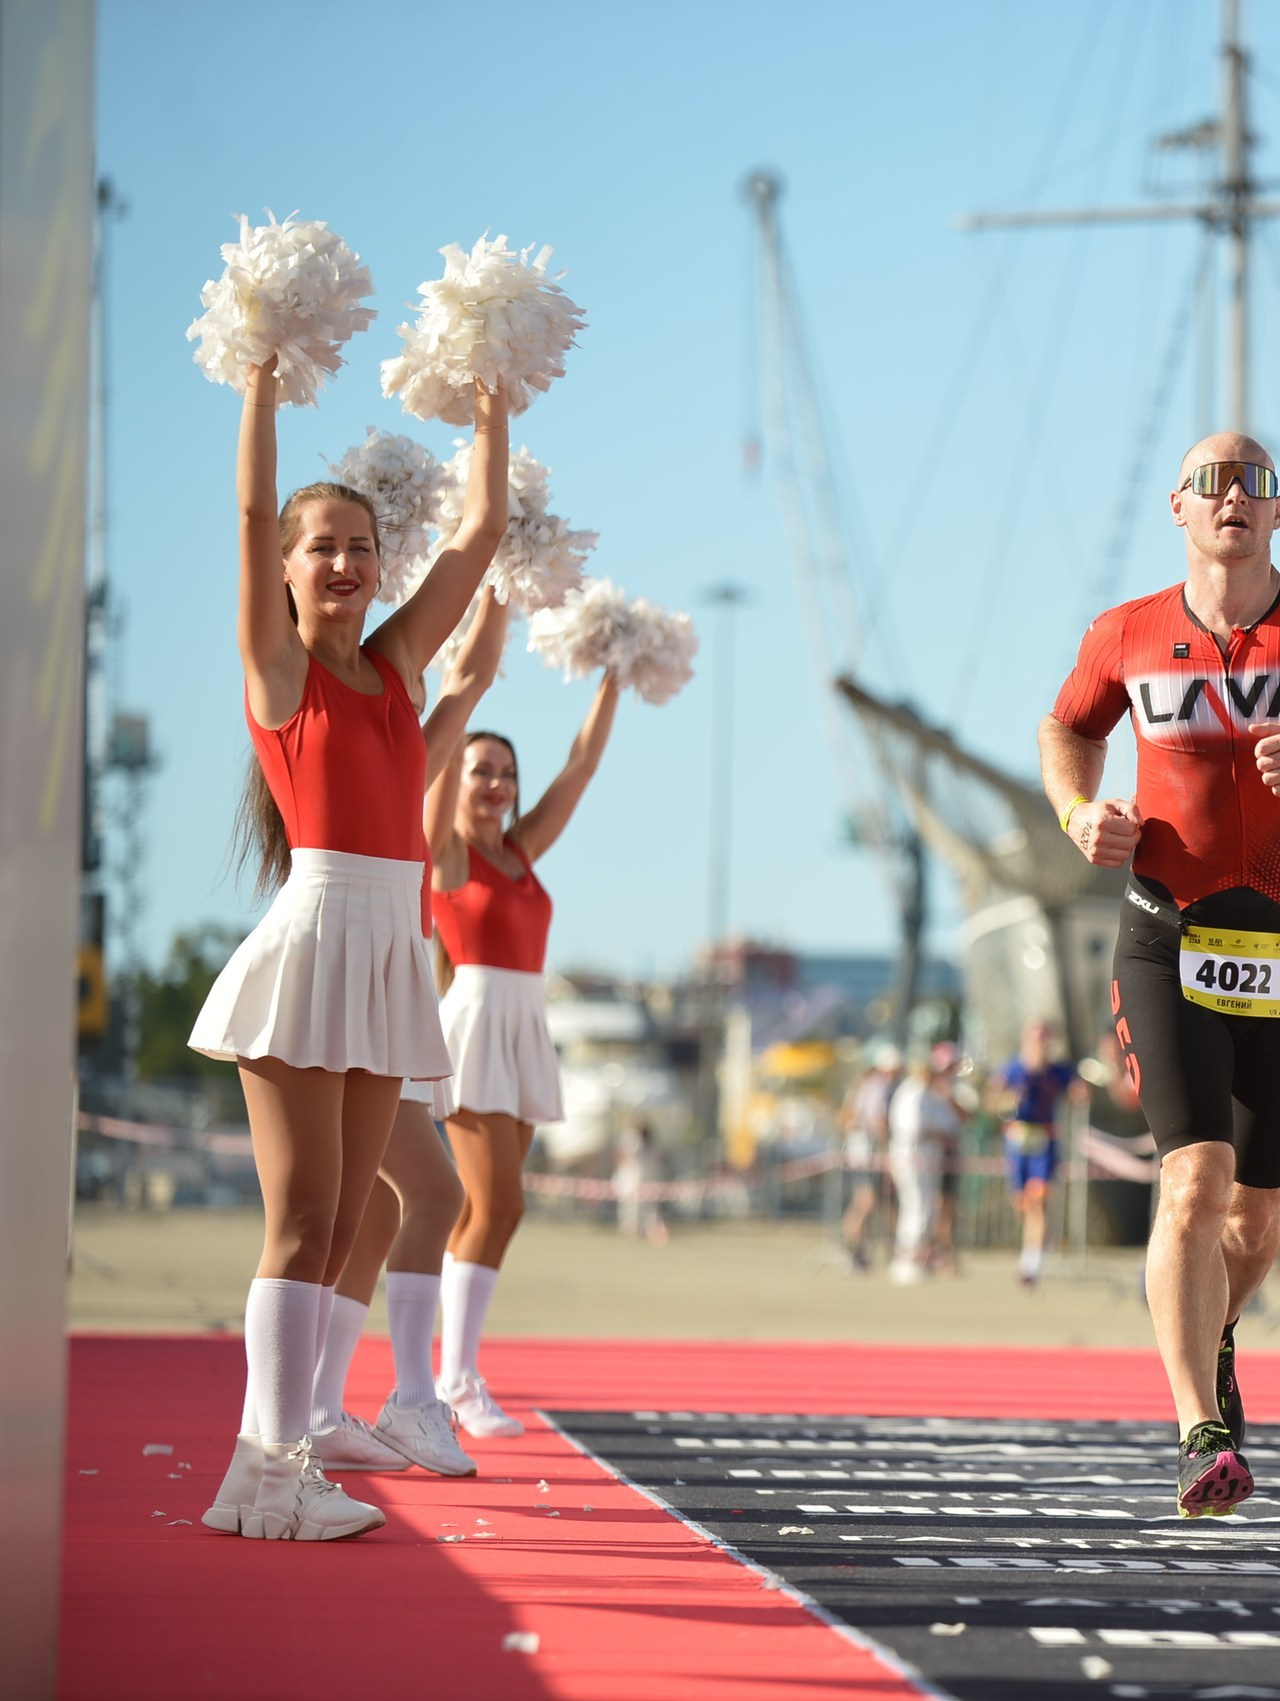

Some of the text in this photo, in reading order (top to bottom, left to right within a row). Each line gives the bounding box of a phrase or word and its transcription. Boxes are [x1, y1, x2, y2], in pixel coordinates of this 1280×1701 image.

[1128, 890, 1160, 915] 2XU
[1195, 959, 1272, 994] 4022
[1216, 998, 1252, 1010] ЕВГЕНИЙ
[797, 1504, 1135, 1518] IRON
